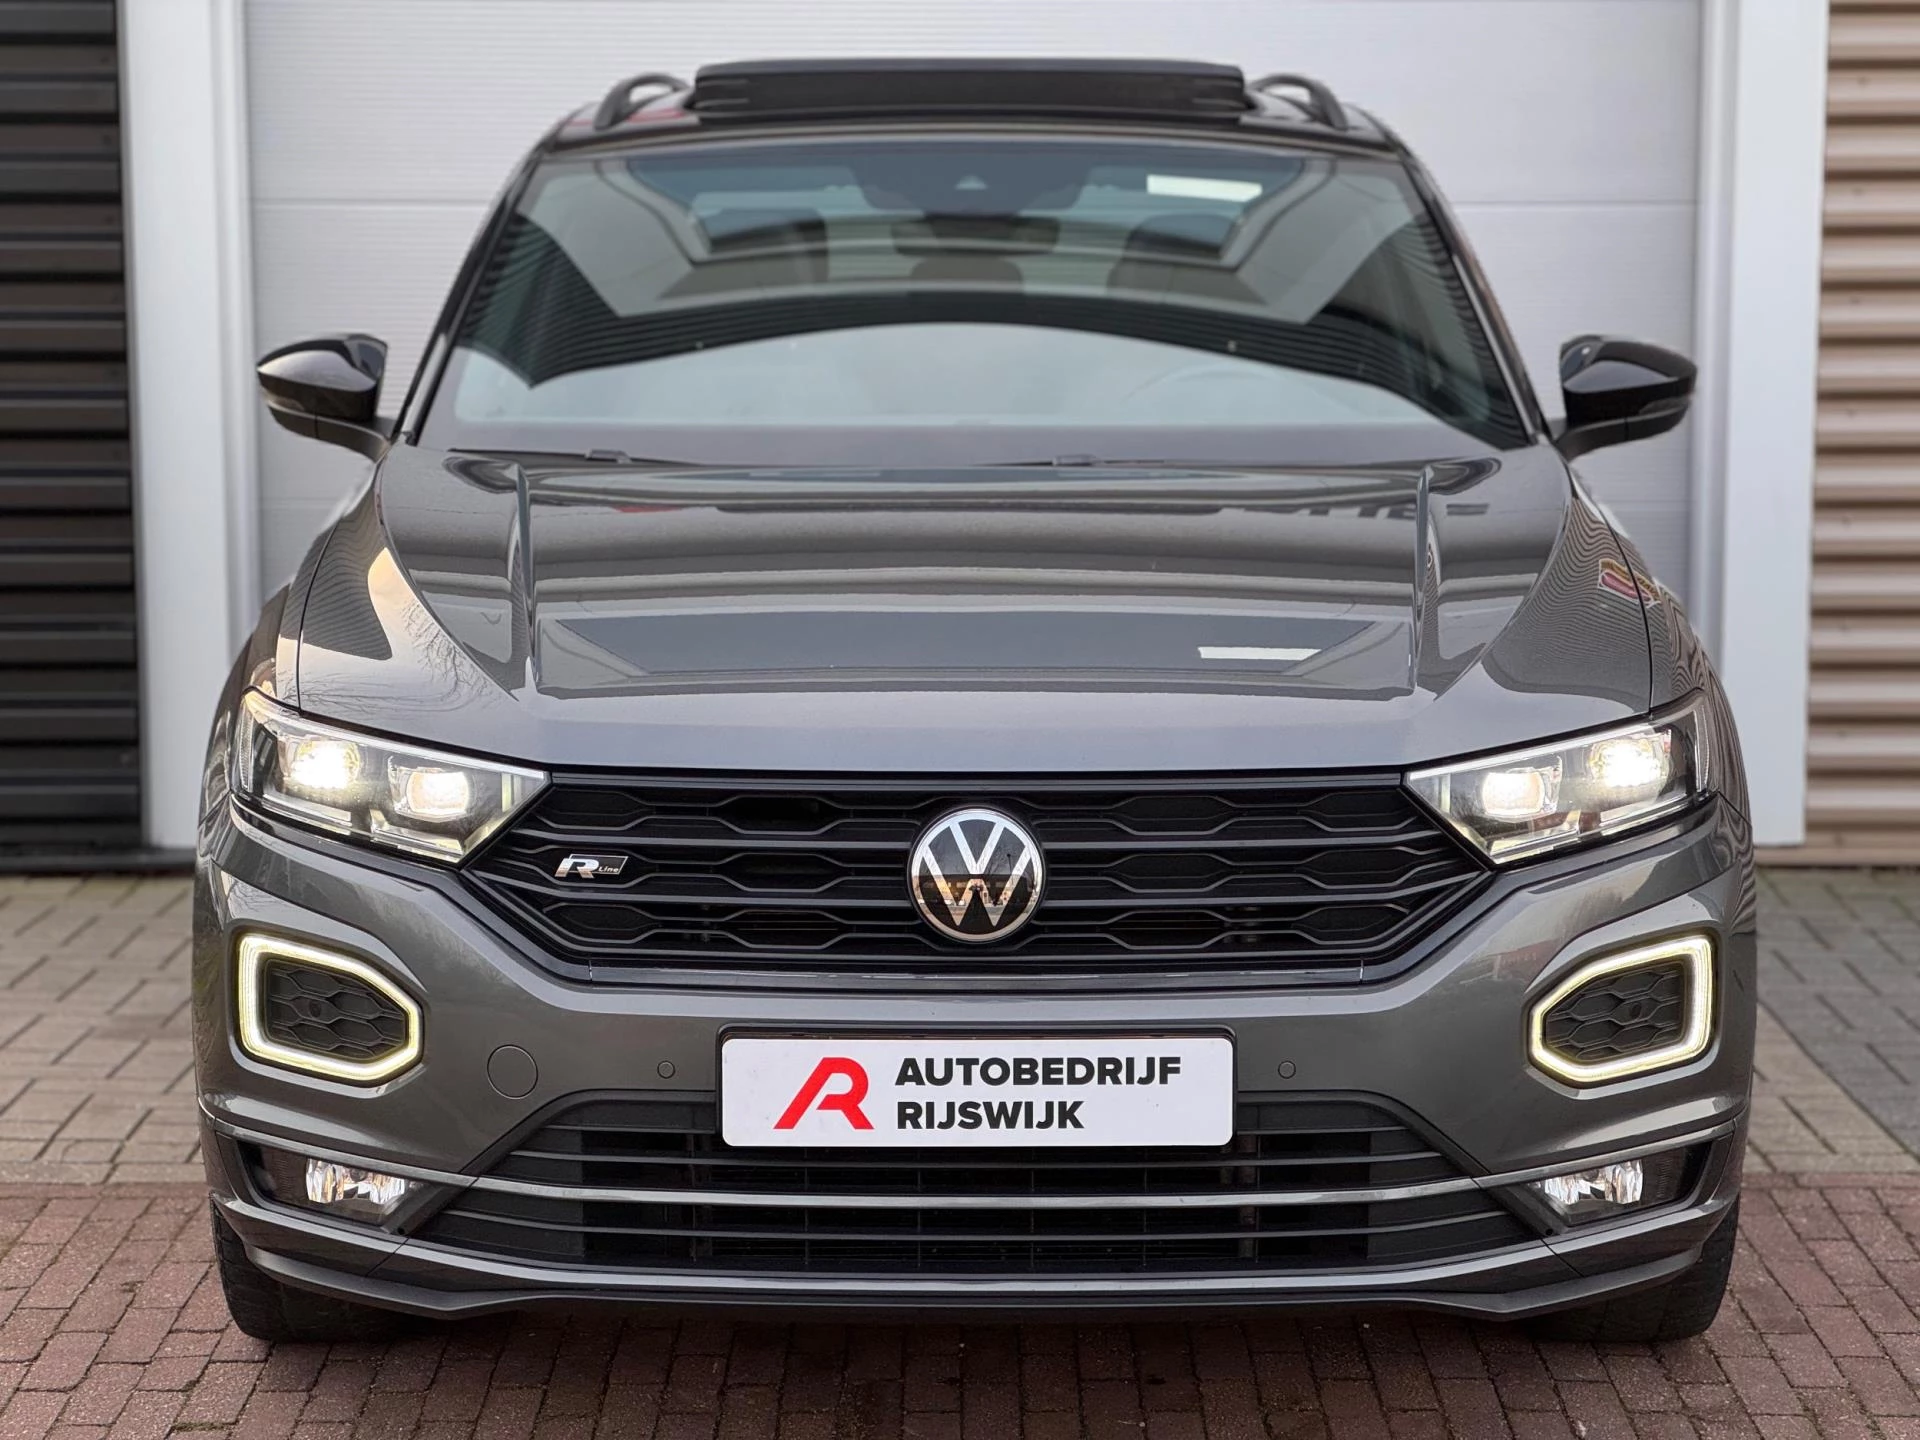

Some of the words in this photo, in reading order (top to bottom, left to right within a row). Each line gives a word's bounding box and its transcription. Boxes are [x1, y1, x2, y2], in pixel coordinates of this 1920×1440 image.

[555, 858, 599, 878] R
[895, 1057, 1181, 1086] AUTOBEDRIJF
[897, 1101, 1085, 1130] RIJSWIJK
